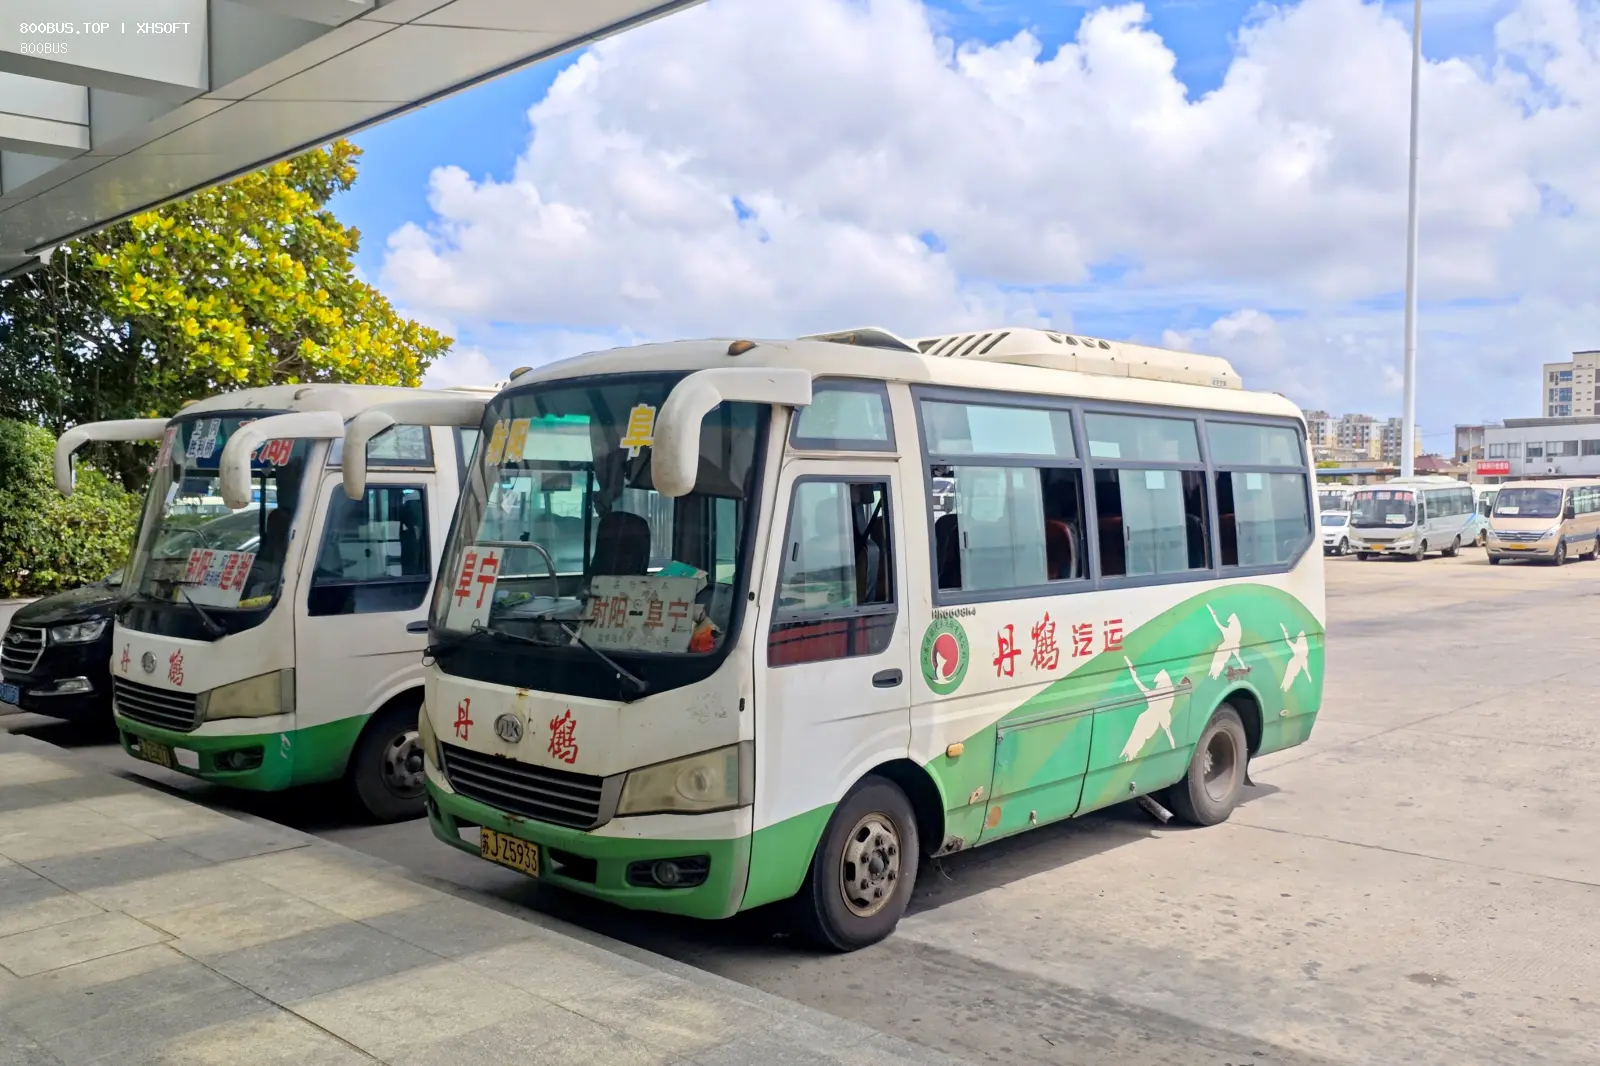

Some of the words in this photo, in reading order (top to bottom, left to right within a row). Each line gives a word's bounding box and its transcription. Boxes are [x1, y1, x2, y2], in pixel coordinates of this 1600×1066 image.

[454, 551, 500, 609] 阜宁
[168, 648, 184, 687] 鹤
[454, 698, 474, 741] 丹
[547, 709, 578, 764] 鹤
